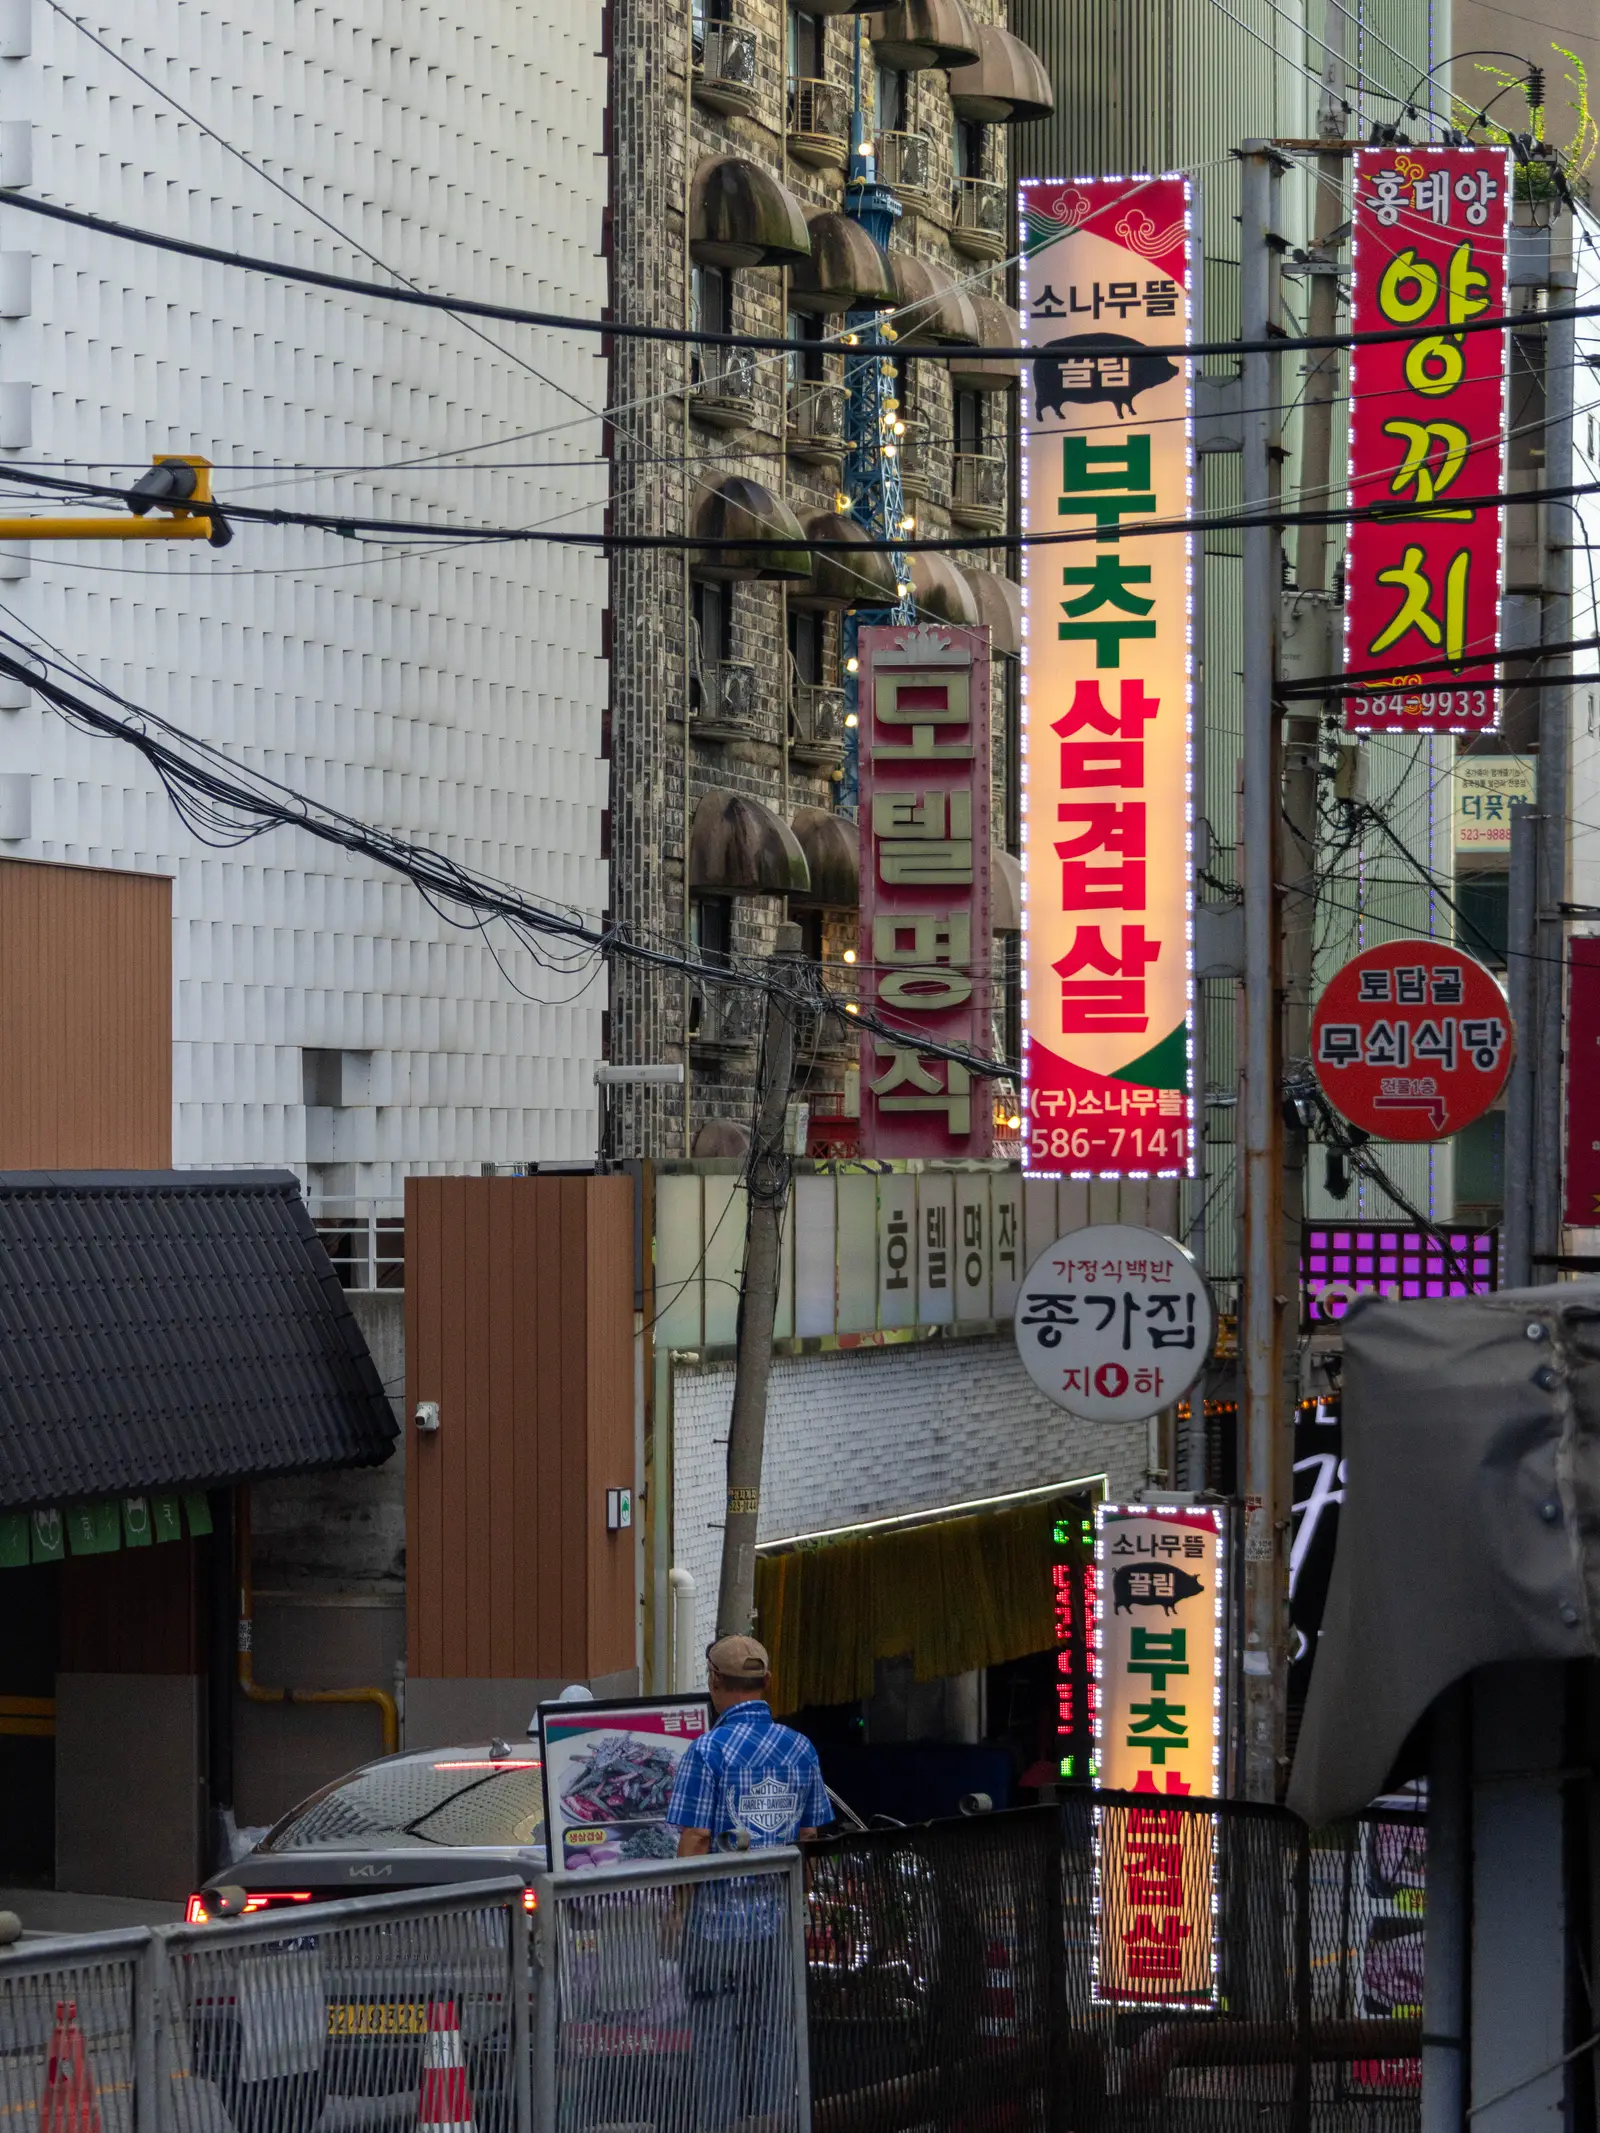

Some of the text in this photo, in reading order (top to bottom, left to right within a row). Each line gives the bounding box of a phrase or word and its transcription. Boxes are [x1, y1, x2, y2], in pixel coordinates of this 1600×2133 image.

[1365, 169, 1497, 226] 홍태양
[1030, 280, 1179, 320] 소나무뜰
[1367, 238, 1492, 676] 양꼬치
[1354, 691, 1486, 717] 584-9933
[1050, 433, 1161, 1034] 부추삼겹살
[1460, 828, 1511, 840] 523-9888
[1359, 966, 1464, 1004] 토담골
[1319, 1018, 1505, 1072] 무쇠식당
[1030, 1088, 1183, 1118] (구)소나무뜰
[1031, 1128, 1184, 1158] 586-7141
[1052, 1259, 1174, 1284] 가정식백반
[1021, 1292, 1196, 1350] 종가집
[1111, 1534, 1205, 1558] 소나무뜰
[1128, 1572, 1175, 1597] 끌림
[754, 1783, 785, 1794] MOTOR
[742, 1798, 793, 1810] HARLEY-DAVIDSON
[754, 1814, 784, 1827] CYCLES
[568, 1830, 604, 1843] 생삼겹살
